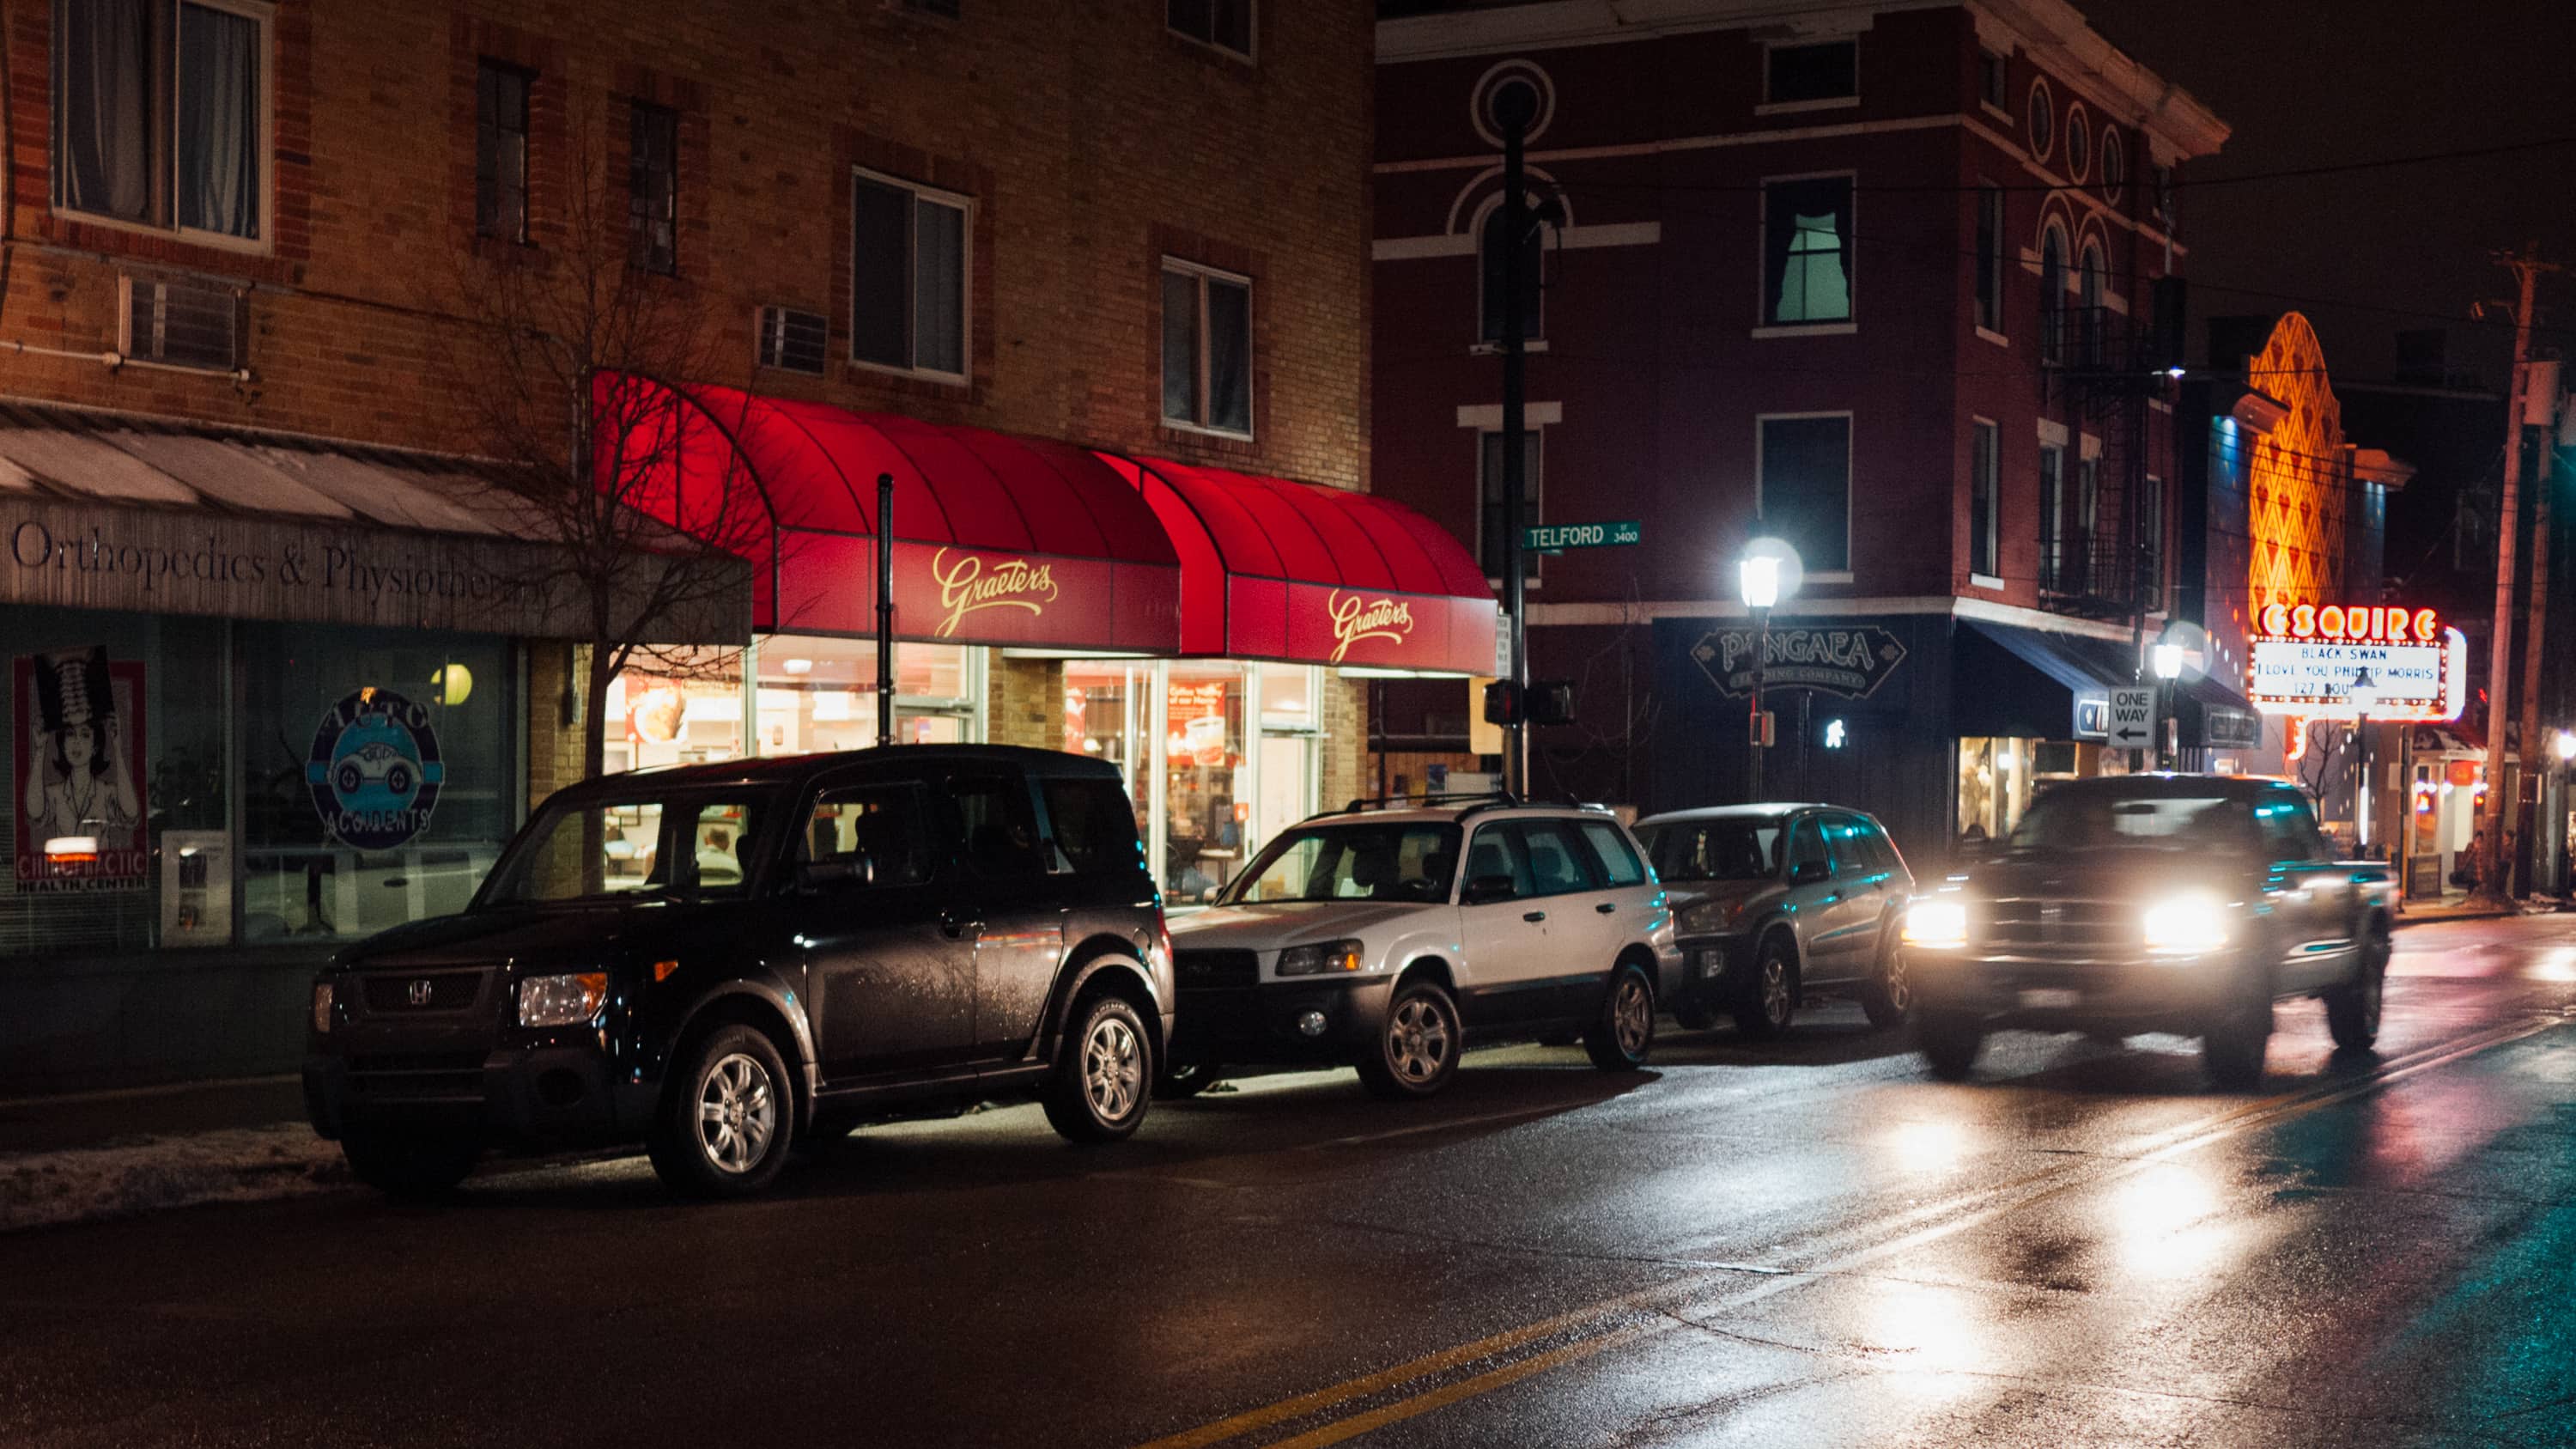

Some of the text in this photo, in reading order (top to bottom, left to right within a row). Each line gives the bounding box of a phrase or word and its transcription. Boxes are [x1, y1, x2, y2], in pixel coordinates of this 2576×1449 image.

[1530, 526, 1604, 547] TELFORD
[1613, 531, 1637, 543] 3400
[12, 521, 266, 591] Orthopedics
[279, 544, 310, 586] &
[933, 546, 1059, 637] Graeter's
[1328, 588, 1413, 663] Graeter's
[2263, 603, 2437, 641] ESQUIRE
[2301, 648, 2387, 660] BLACK SWAN
[2306, 666, 2328, 677] YOU
[2335, 666, 2382, 678] PHILIP
[2387, 667, 2433, 679] MORRIS
[2116, 692, 2148, 706] ONE
[323, 701, 428, 729] AUTO
[2115, 709, 2148, 722] WAY
[323, 808, 431, 837] ACCIDENTS
[16, 878, 147, 893] HEALTH CENTER
